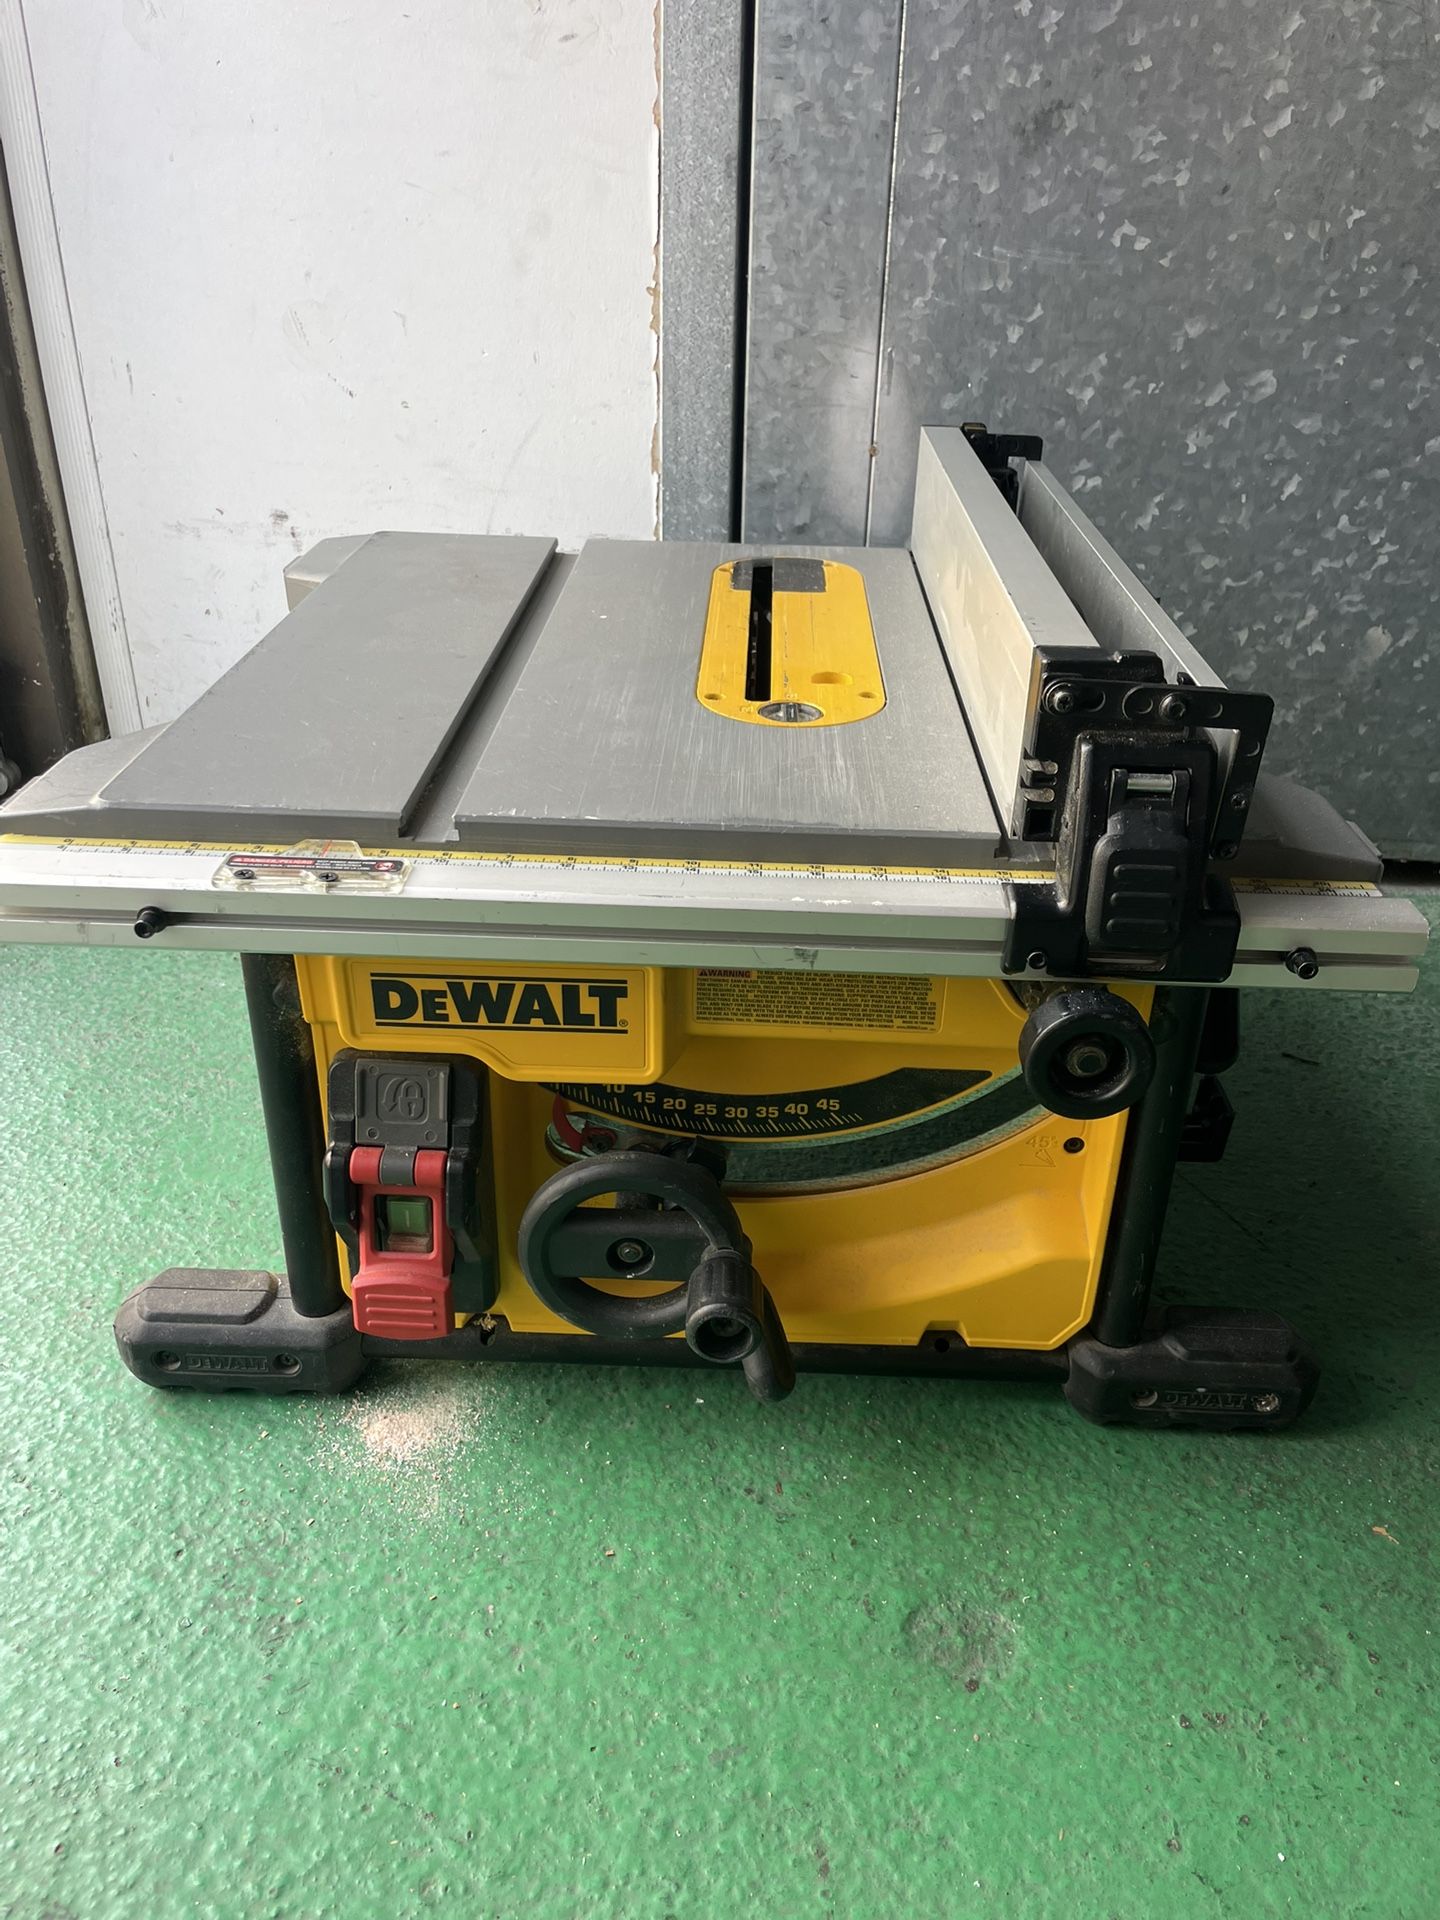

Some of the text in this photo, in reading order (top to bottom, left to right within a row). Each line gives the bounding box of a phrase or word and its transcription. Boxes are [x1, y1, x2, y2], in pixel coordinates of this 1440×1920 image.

[708, 969, 751, 978] WARNING
[633, 1091, 656, 1104] 15
[663, 1098, 686, 1110] 20
[694, 1103, 717, 1116] 25
[724, 1107, 748, 1119] 30
[755, 1106, 779, 1118] 35
[784, 1103, 808, 1115] 40
[816, 1098, 840, 1111] 45
